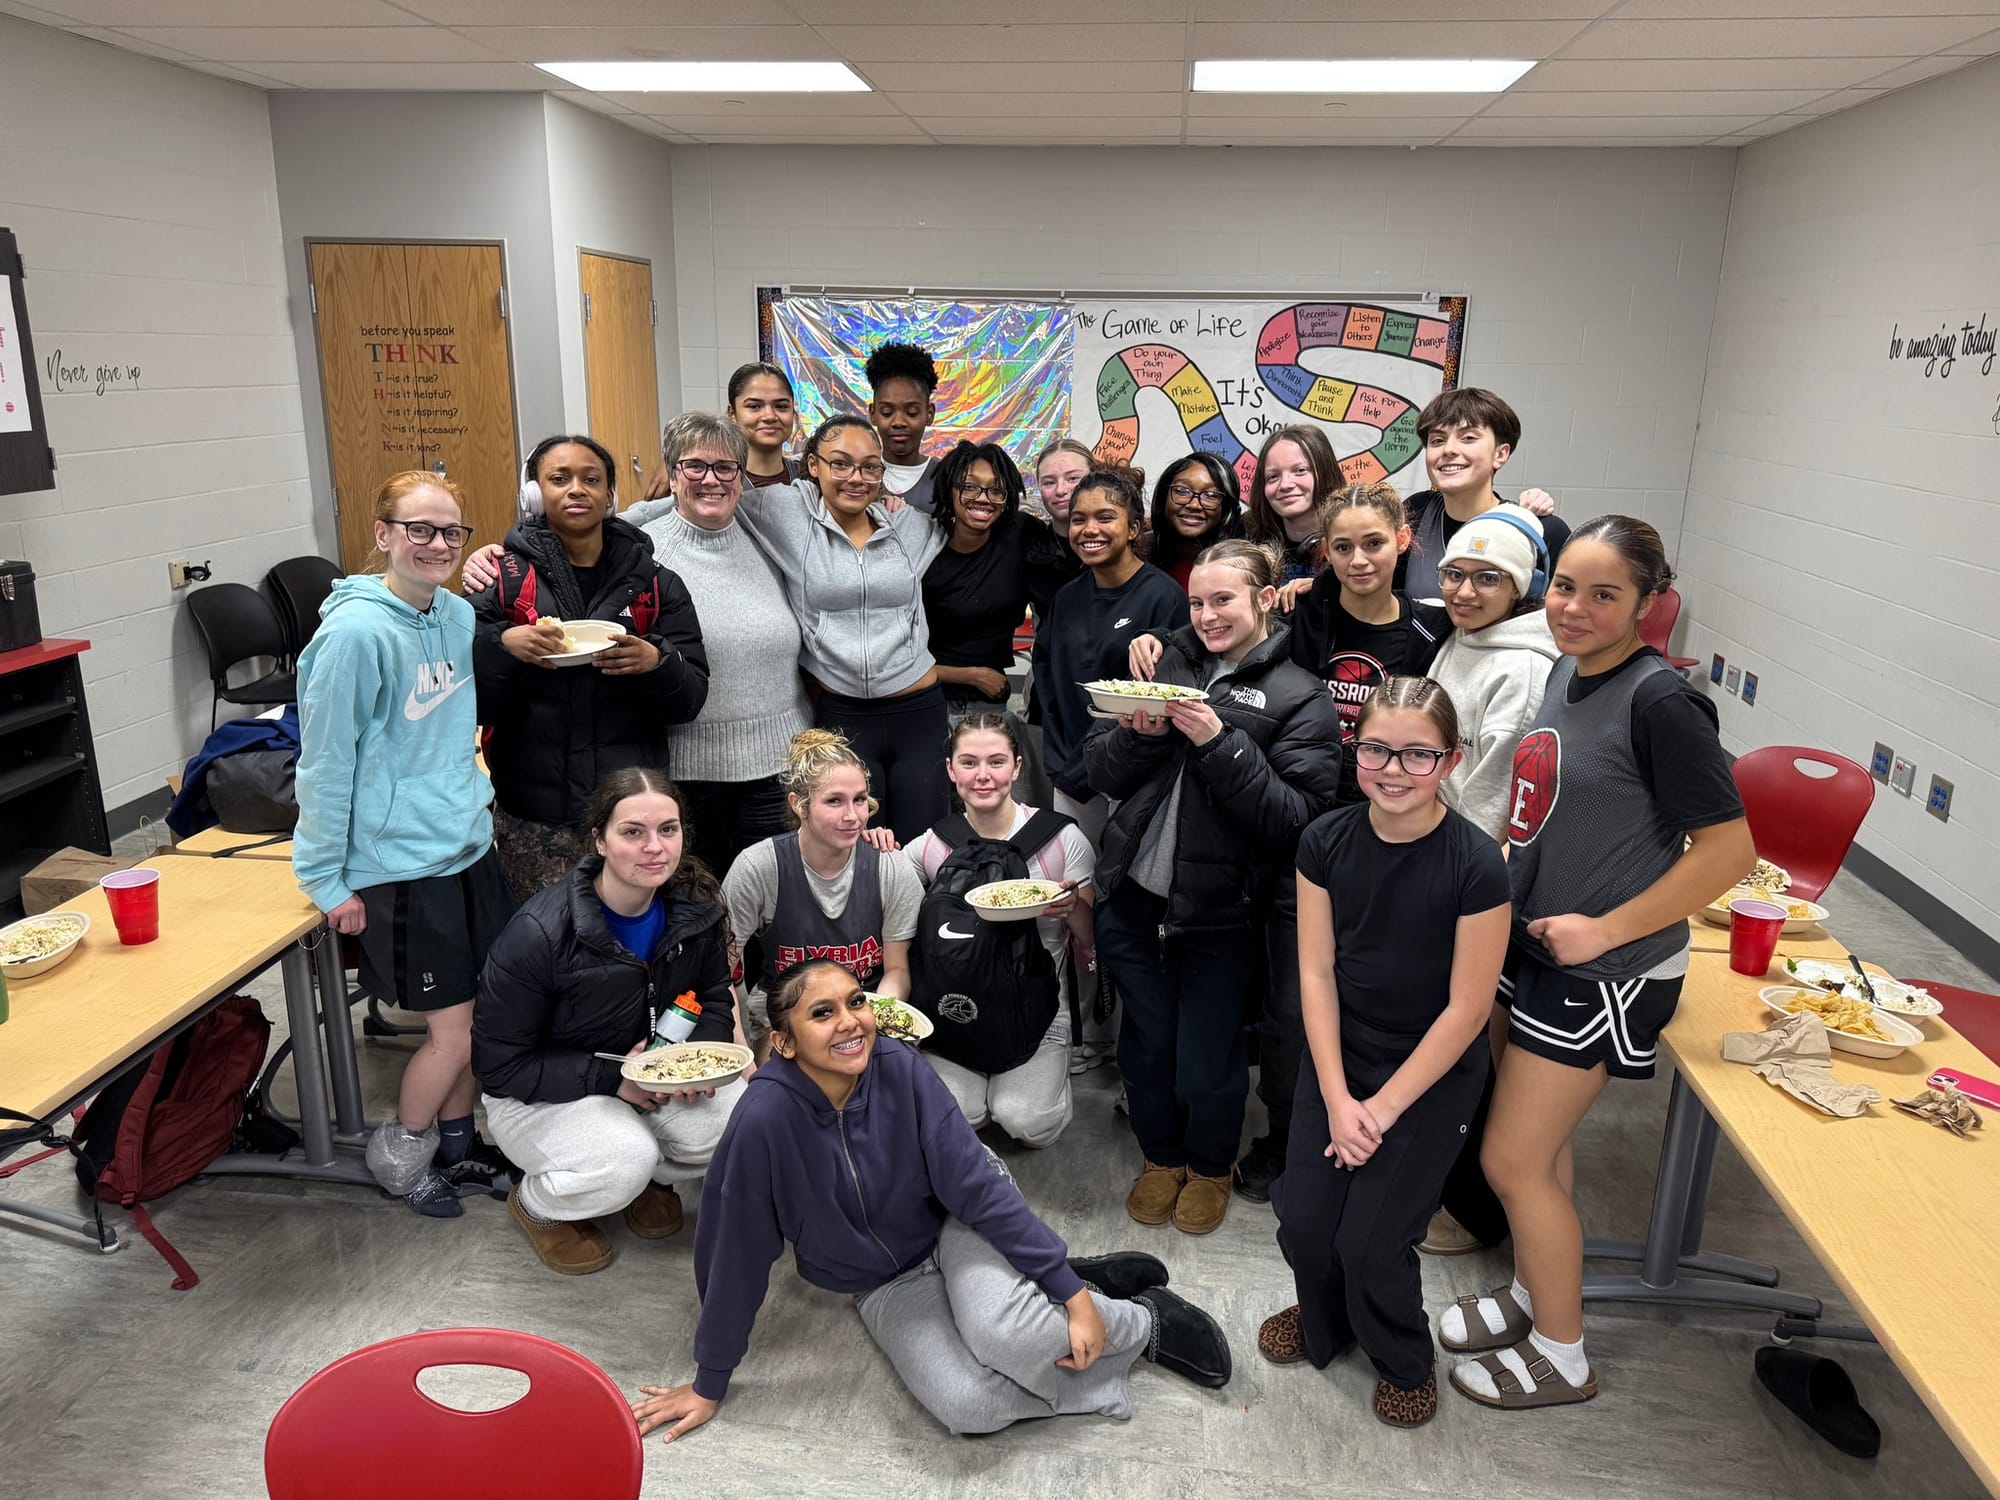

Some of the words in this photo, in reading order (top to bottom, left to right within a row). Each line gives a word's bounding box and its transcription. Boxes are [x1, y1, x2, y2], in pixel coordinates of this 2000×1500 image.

[1298, 308, 1341, 322] Recognize
[1352, 311, 1381, 323] Listen
[1075, 311, 1097, 329] The
[1102, 309, 1162, 340] Game
[1310, 320, 1329, 335] your
[1360, 324, 1370, 332] to
[360, 325, 400, 336] before
[402, 327, 421, 338] you
[423, 325, 455, 338] speak
[1346, 331, 1373, 342] Others
[1414, 336, 1447, 349] Change
[1889, 322, 1904, 360] be
[1906, 322, 1957, 378] amazing
[1961, 312, 1998, 376] today
[1133, 348, 1149, 358] Do
[1153, 350, 1178, 361] your
[1143, 360, 1164, 369] own
[46, 348, 89, 393] Never
[96, 364, 122, 396] give
[126, 365, 141, 391] up
[373, 371, 384, 383] T
[403, 374, 410, 384] it
[1134, 368, 1162, 382] Thing
[1281, 366, 1303, 387] Think
[373, 388, 385, 400] H
[403, 390, 411, 399] it
[414, 389, 452, 401] helpful?
[1171, 386, 1203, 396] Make
[1217, 377, 1265, 409] It's
[1317, 380, 1344, 396] Pause
[1318, 395, 1335, 405] and
[1360, 391, 1378, 404] Ask
[403, 407, 410, 416] it
[414, 407, 458, 420] inspiring?
[1179, 402, 1217, 415] Mistakes
[1308, 400, 1335, 417] Think
[1363, 406, 1382, 420] Help
[1400, 415, 1415, 426] Go
[381, 422, 392, 433] N
[408, 424, 416, 433] it
[1105, 424, 1136, 445] Change
[1201, 432, 1223, 444] Feel
[1393, 432, 1409, 444] the
[406, 443, 414, 452] it
[1384, 442, 1409, 453] norm
[1354, 458, 1373, 470] the
[1350, 471, 1362, 480] at
[1509, 777, 1536, 832] E
